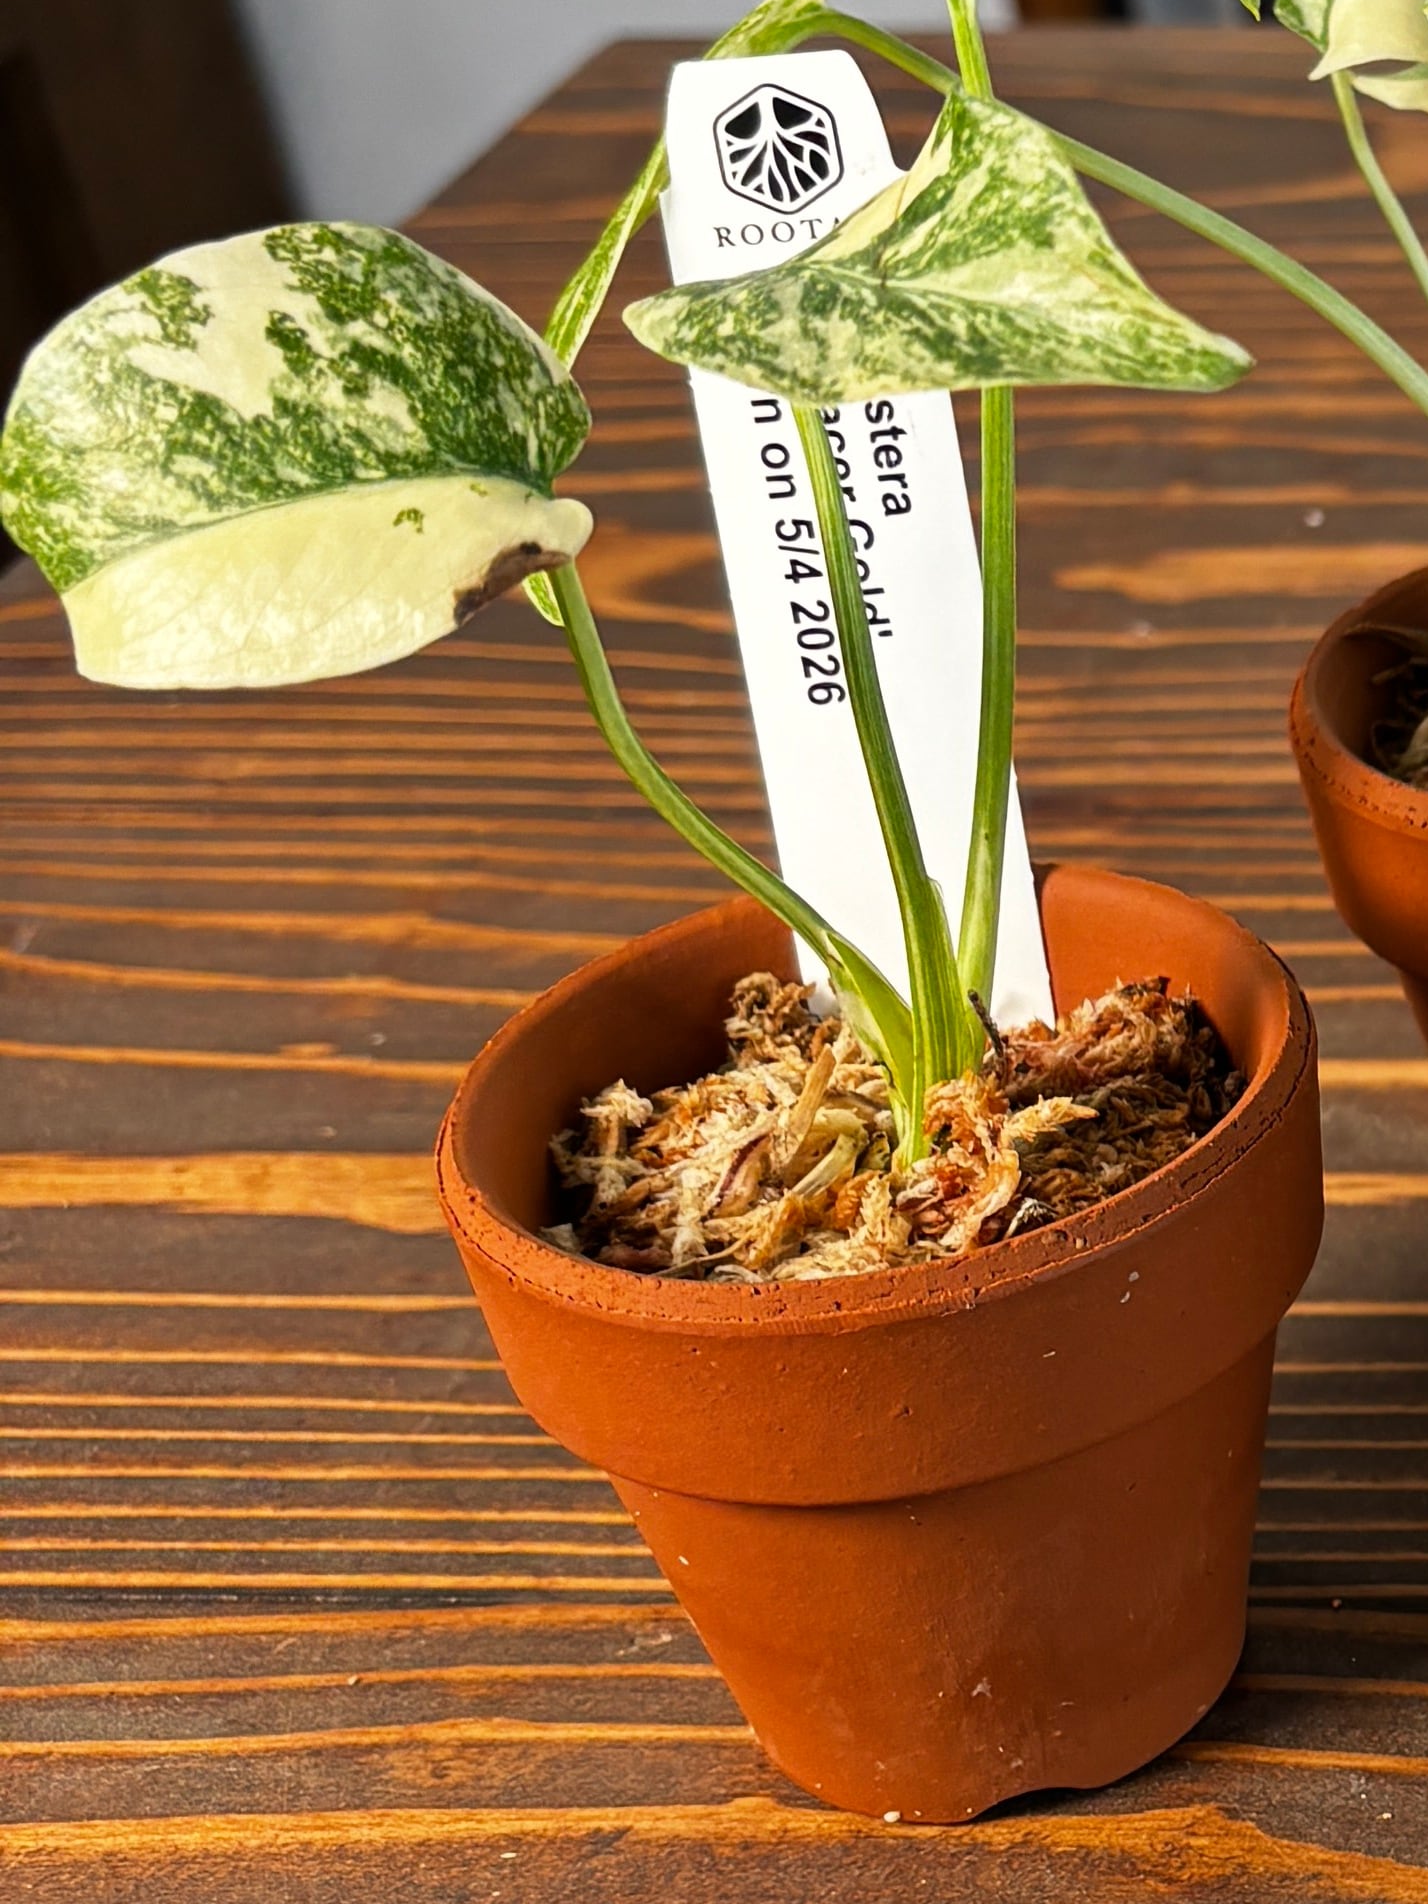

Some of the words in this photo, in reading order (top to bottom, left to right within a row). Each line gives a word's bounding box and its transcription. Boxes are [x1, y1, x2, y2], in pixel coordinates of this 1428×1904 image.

[713, 217, 840, 247] ROOT
[760, 442, 797, 499] on
[864, 399, 912, 517] stera
[775, 518, 824, 584] 5/4
[790, 599, 846, 705] 2026
